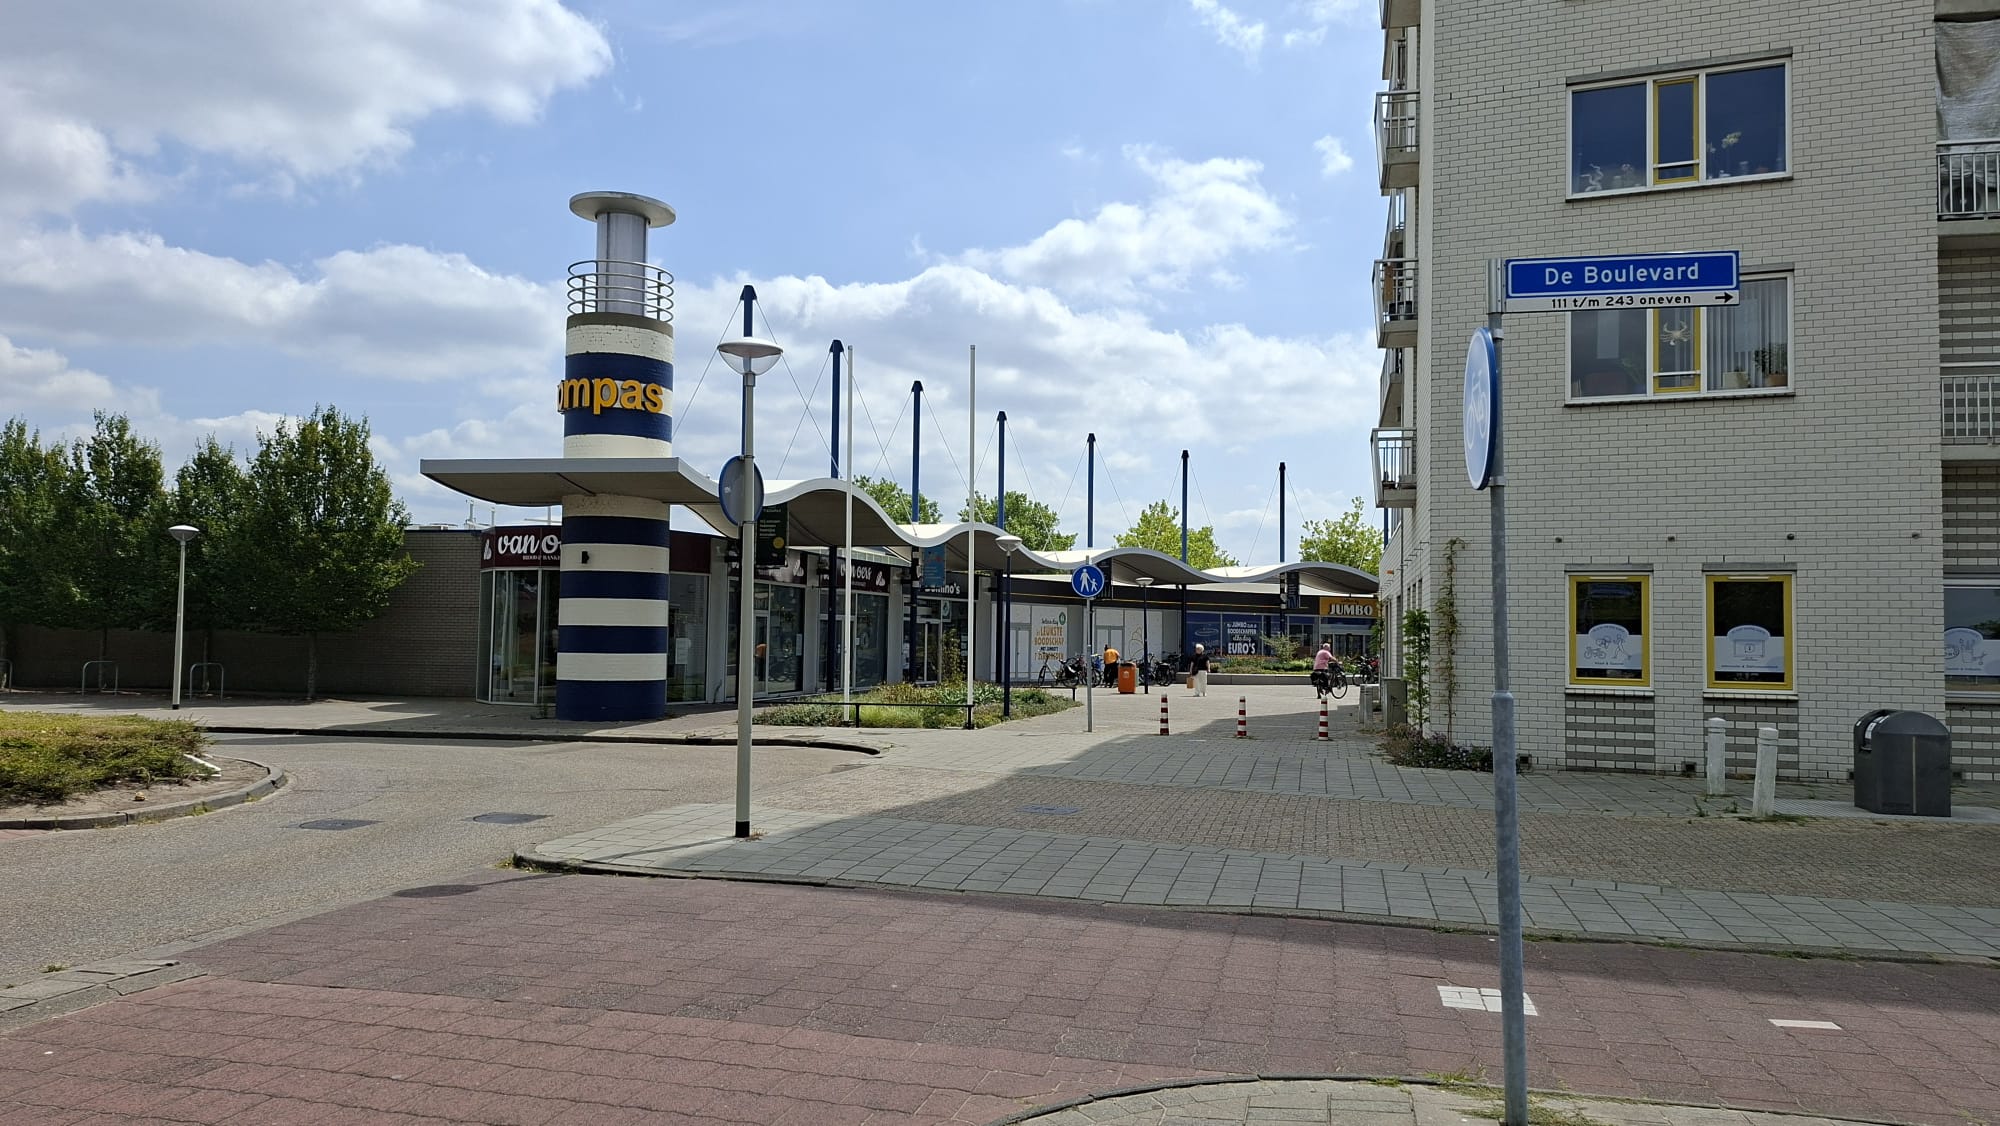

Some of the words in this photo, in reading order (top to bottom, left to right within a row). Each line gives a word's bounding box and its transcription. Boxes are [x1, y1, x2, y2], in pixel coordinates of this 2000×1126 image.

[1545, 267, 1573, 286] De
[1584, 262, 1699, 285] Boulevard
[1551, 298, 1567, 309] 111
[1573, 297, 1600, 308] t/m
[1605, 296, 1634, 306] 243
[1639, 295, 1691, 305] oneven
[557, 377, 663, 415] mpas
[497, 534, 540, 555] van
[1329, 603, 1373, 616] JUMBO
[1227, 642, 1256, 655] EURO'S
